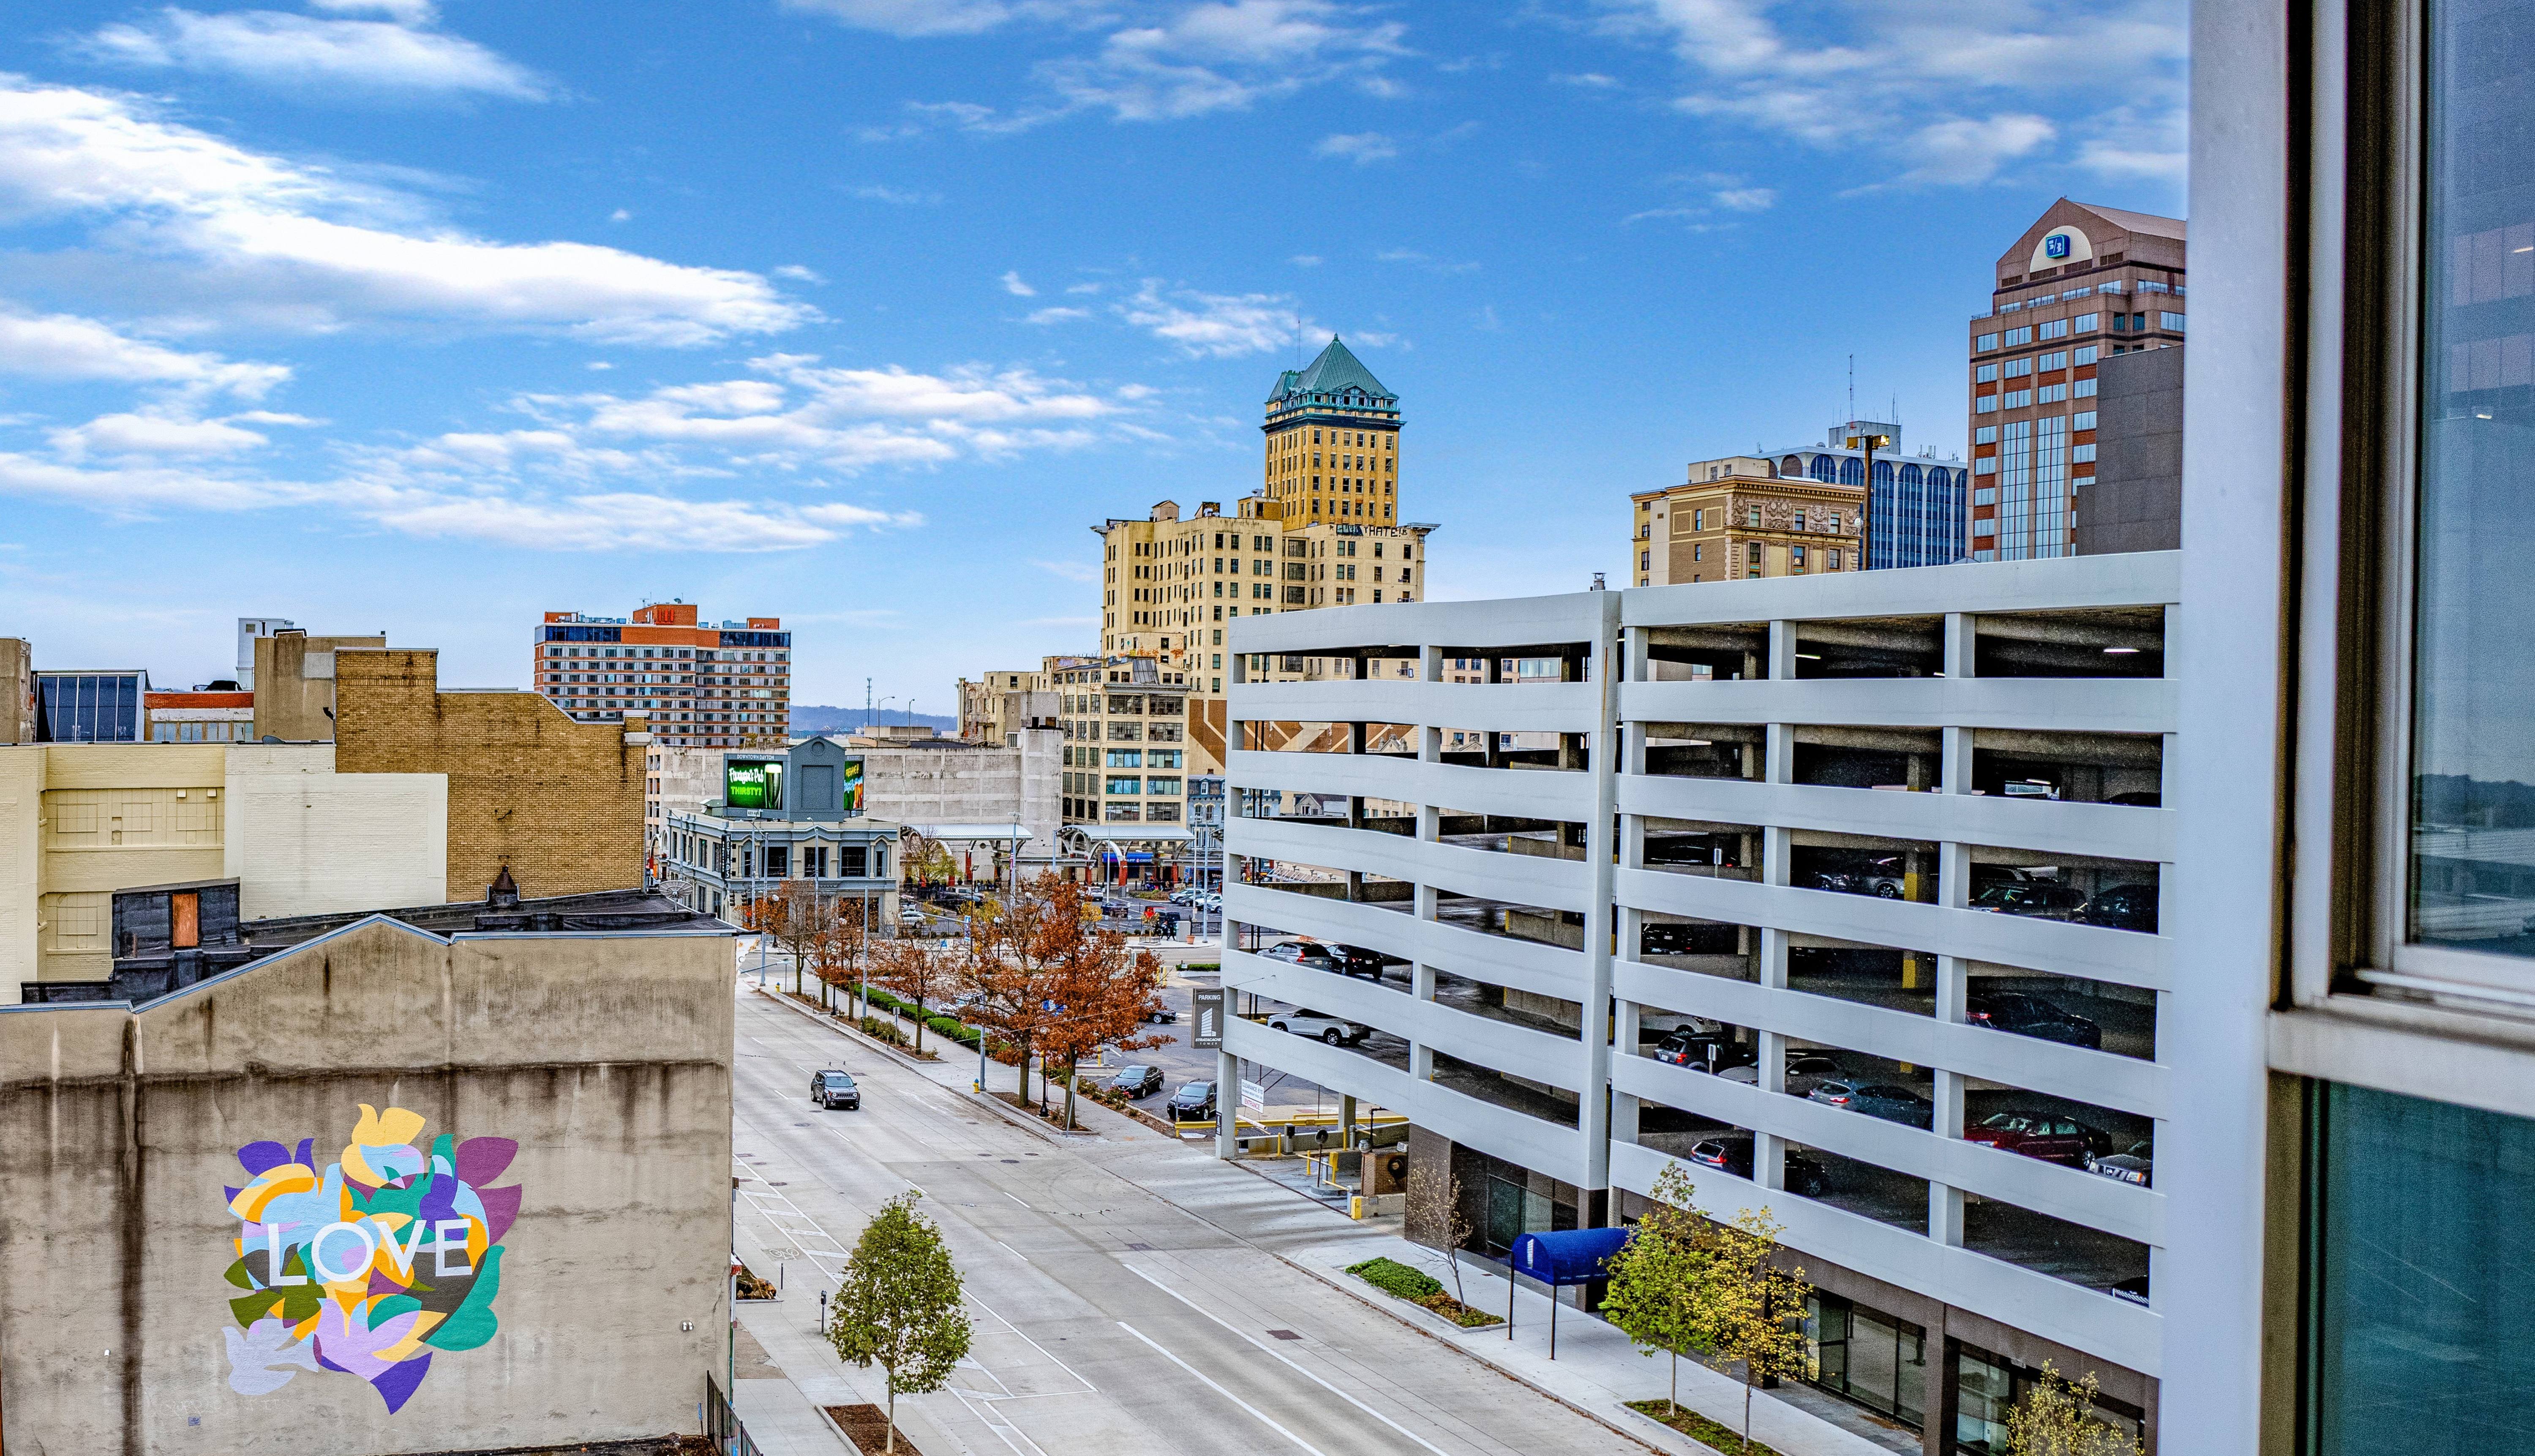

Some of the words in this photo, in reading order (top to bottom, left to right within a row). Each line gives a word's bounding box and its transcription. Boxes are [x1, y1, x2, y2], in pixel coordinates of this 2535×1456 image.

[753, 768, 764, 783] Pub
[731, 786, 762, 796] THIRSTY?
[1244, 1098, 1260, 1110] ENTRANCE
[267, 1218, 472, 1286] LOVE
